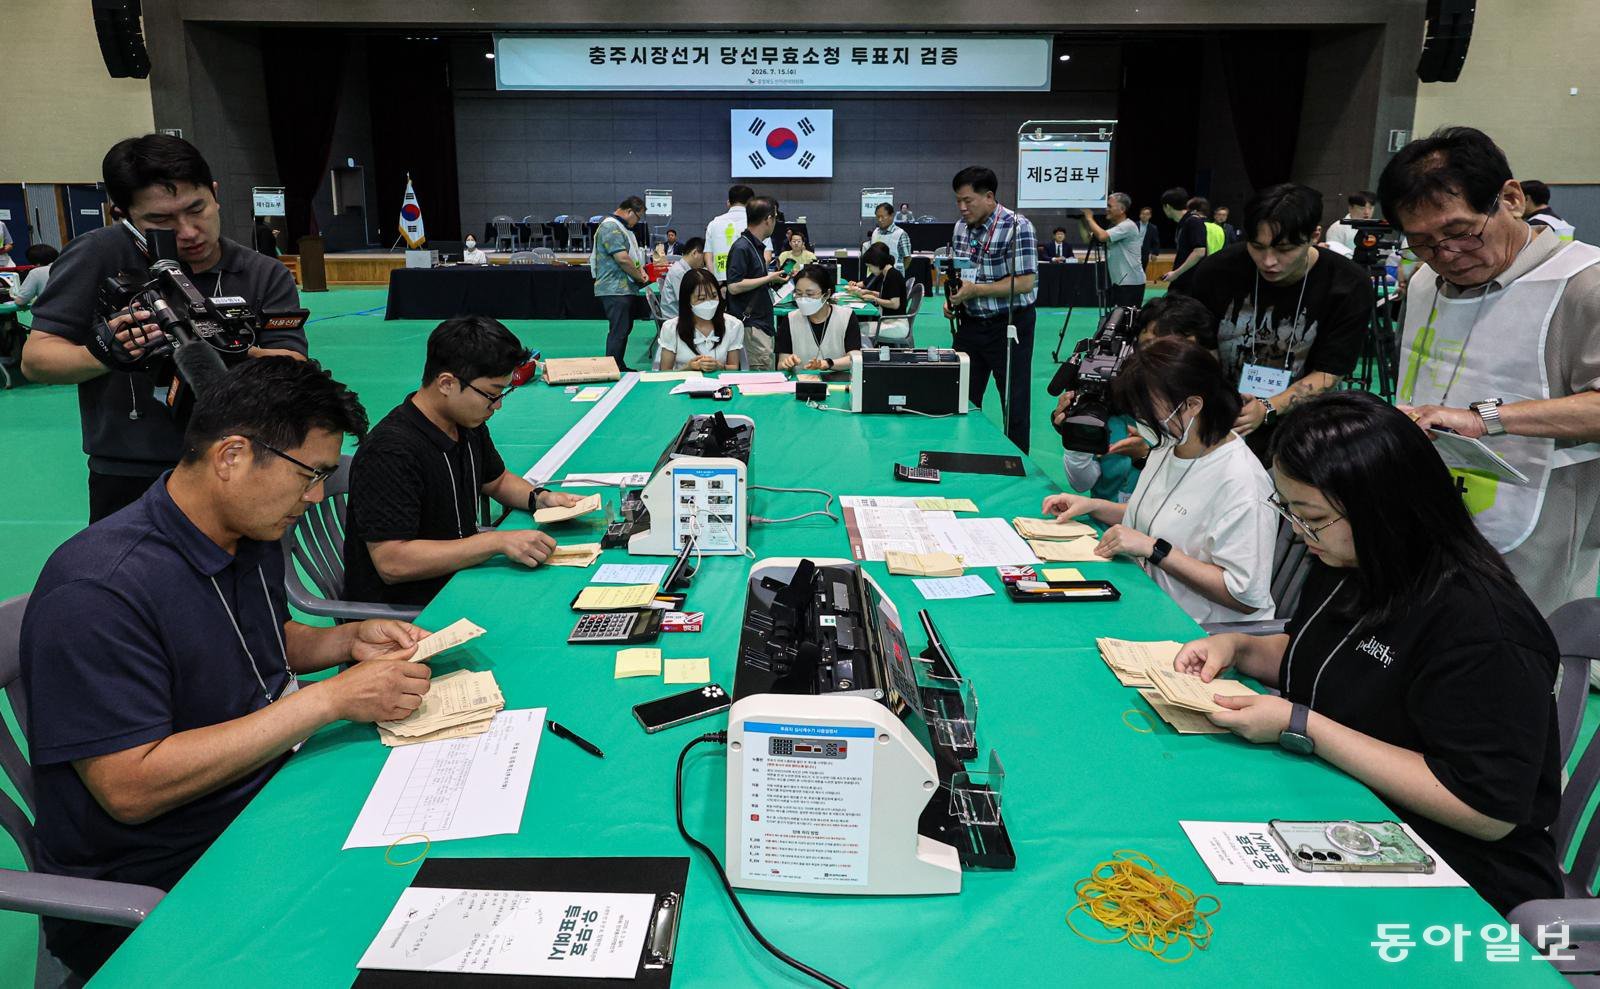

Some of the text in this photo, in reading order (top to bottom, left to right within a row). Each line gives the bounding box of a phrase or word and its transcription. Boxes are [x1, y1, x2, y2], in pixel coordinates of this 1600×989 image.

[588, 46, 958, 66] 충주시장선거 당선무효소청 투표지 검증
[1026, 166, 1100, 184] 제5검표부
[1235, 835, 1271, 870] 유·무효
[1248, 832, 1290, 874] 투표예시
[547, 905, 582, 961] 투표예시
[569, 910, 599, 956] 유·무효
